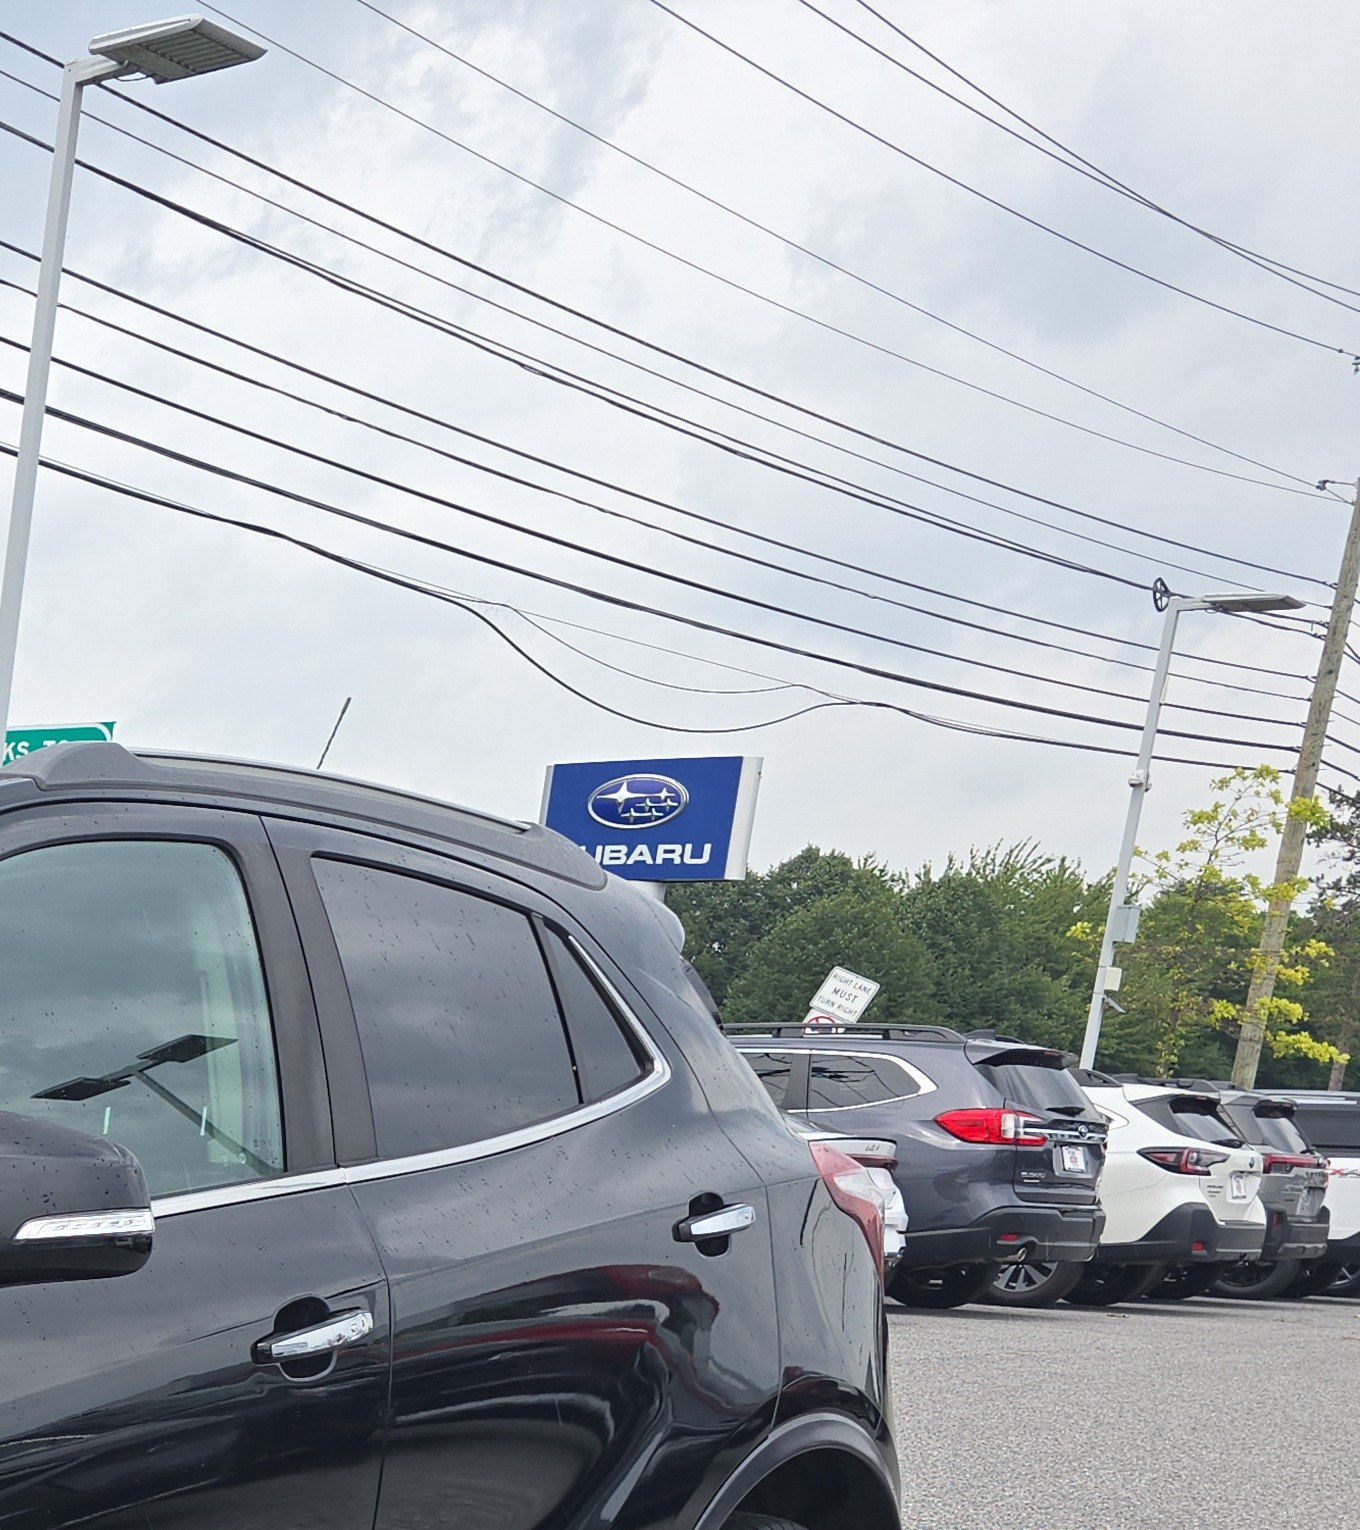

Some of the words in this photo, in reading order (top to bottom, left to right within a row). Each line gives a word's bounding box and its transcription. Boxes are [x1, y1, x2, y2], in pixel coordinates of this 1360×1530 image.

[832, 986, 859, 1003] MUST
[833, 973, 854, 987] RIGHT
[853, 982, 872, 995] LANE
[817, 995, 835, 1008] TURN
[836, 1003, 858, 1016] RIGHT
